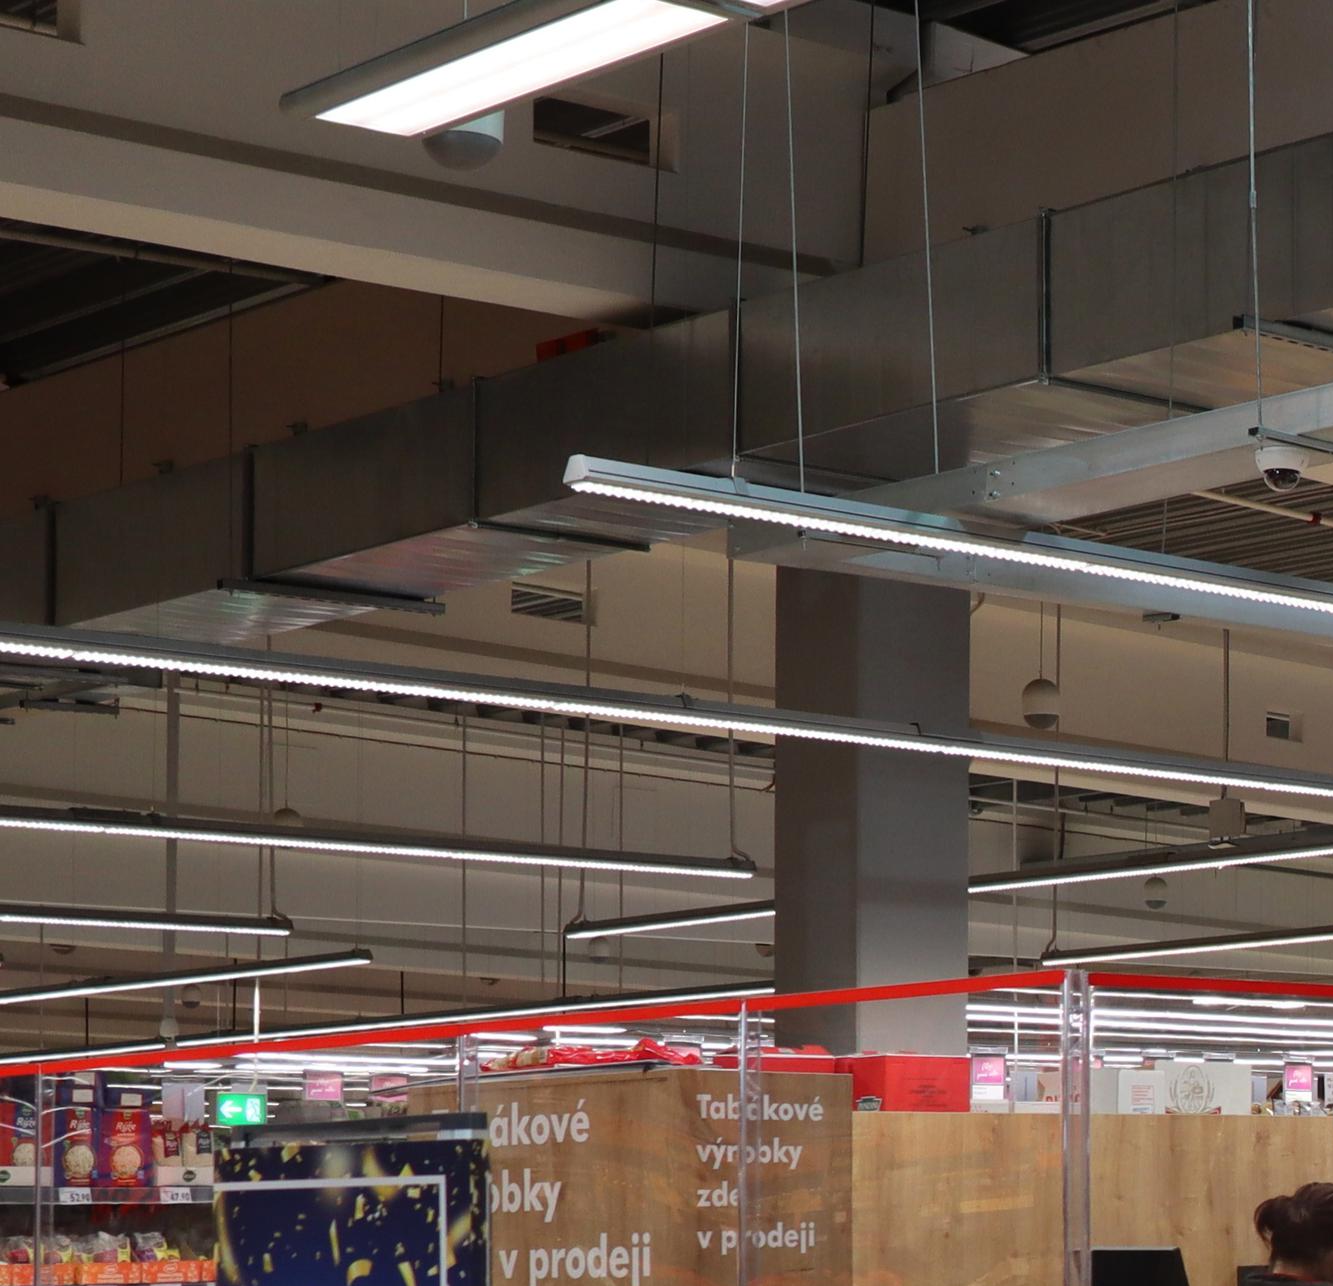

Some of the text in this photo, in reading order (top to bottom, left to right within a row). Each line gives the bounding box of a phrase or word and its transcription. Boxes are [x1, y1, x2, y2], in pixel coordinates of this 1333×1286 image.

[696, 1094, 824, 1122] Tabákové
[696, 1137, 803, 1170] výrobky
[697, 1181, 741, 1208] zde
[697, 1221, 816, 1256] v prodeji
[500, 1250, 518, 1279] v
